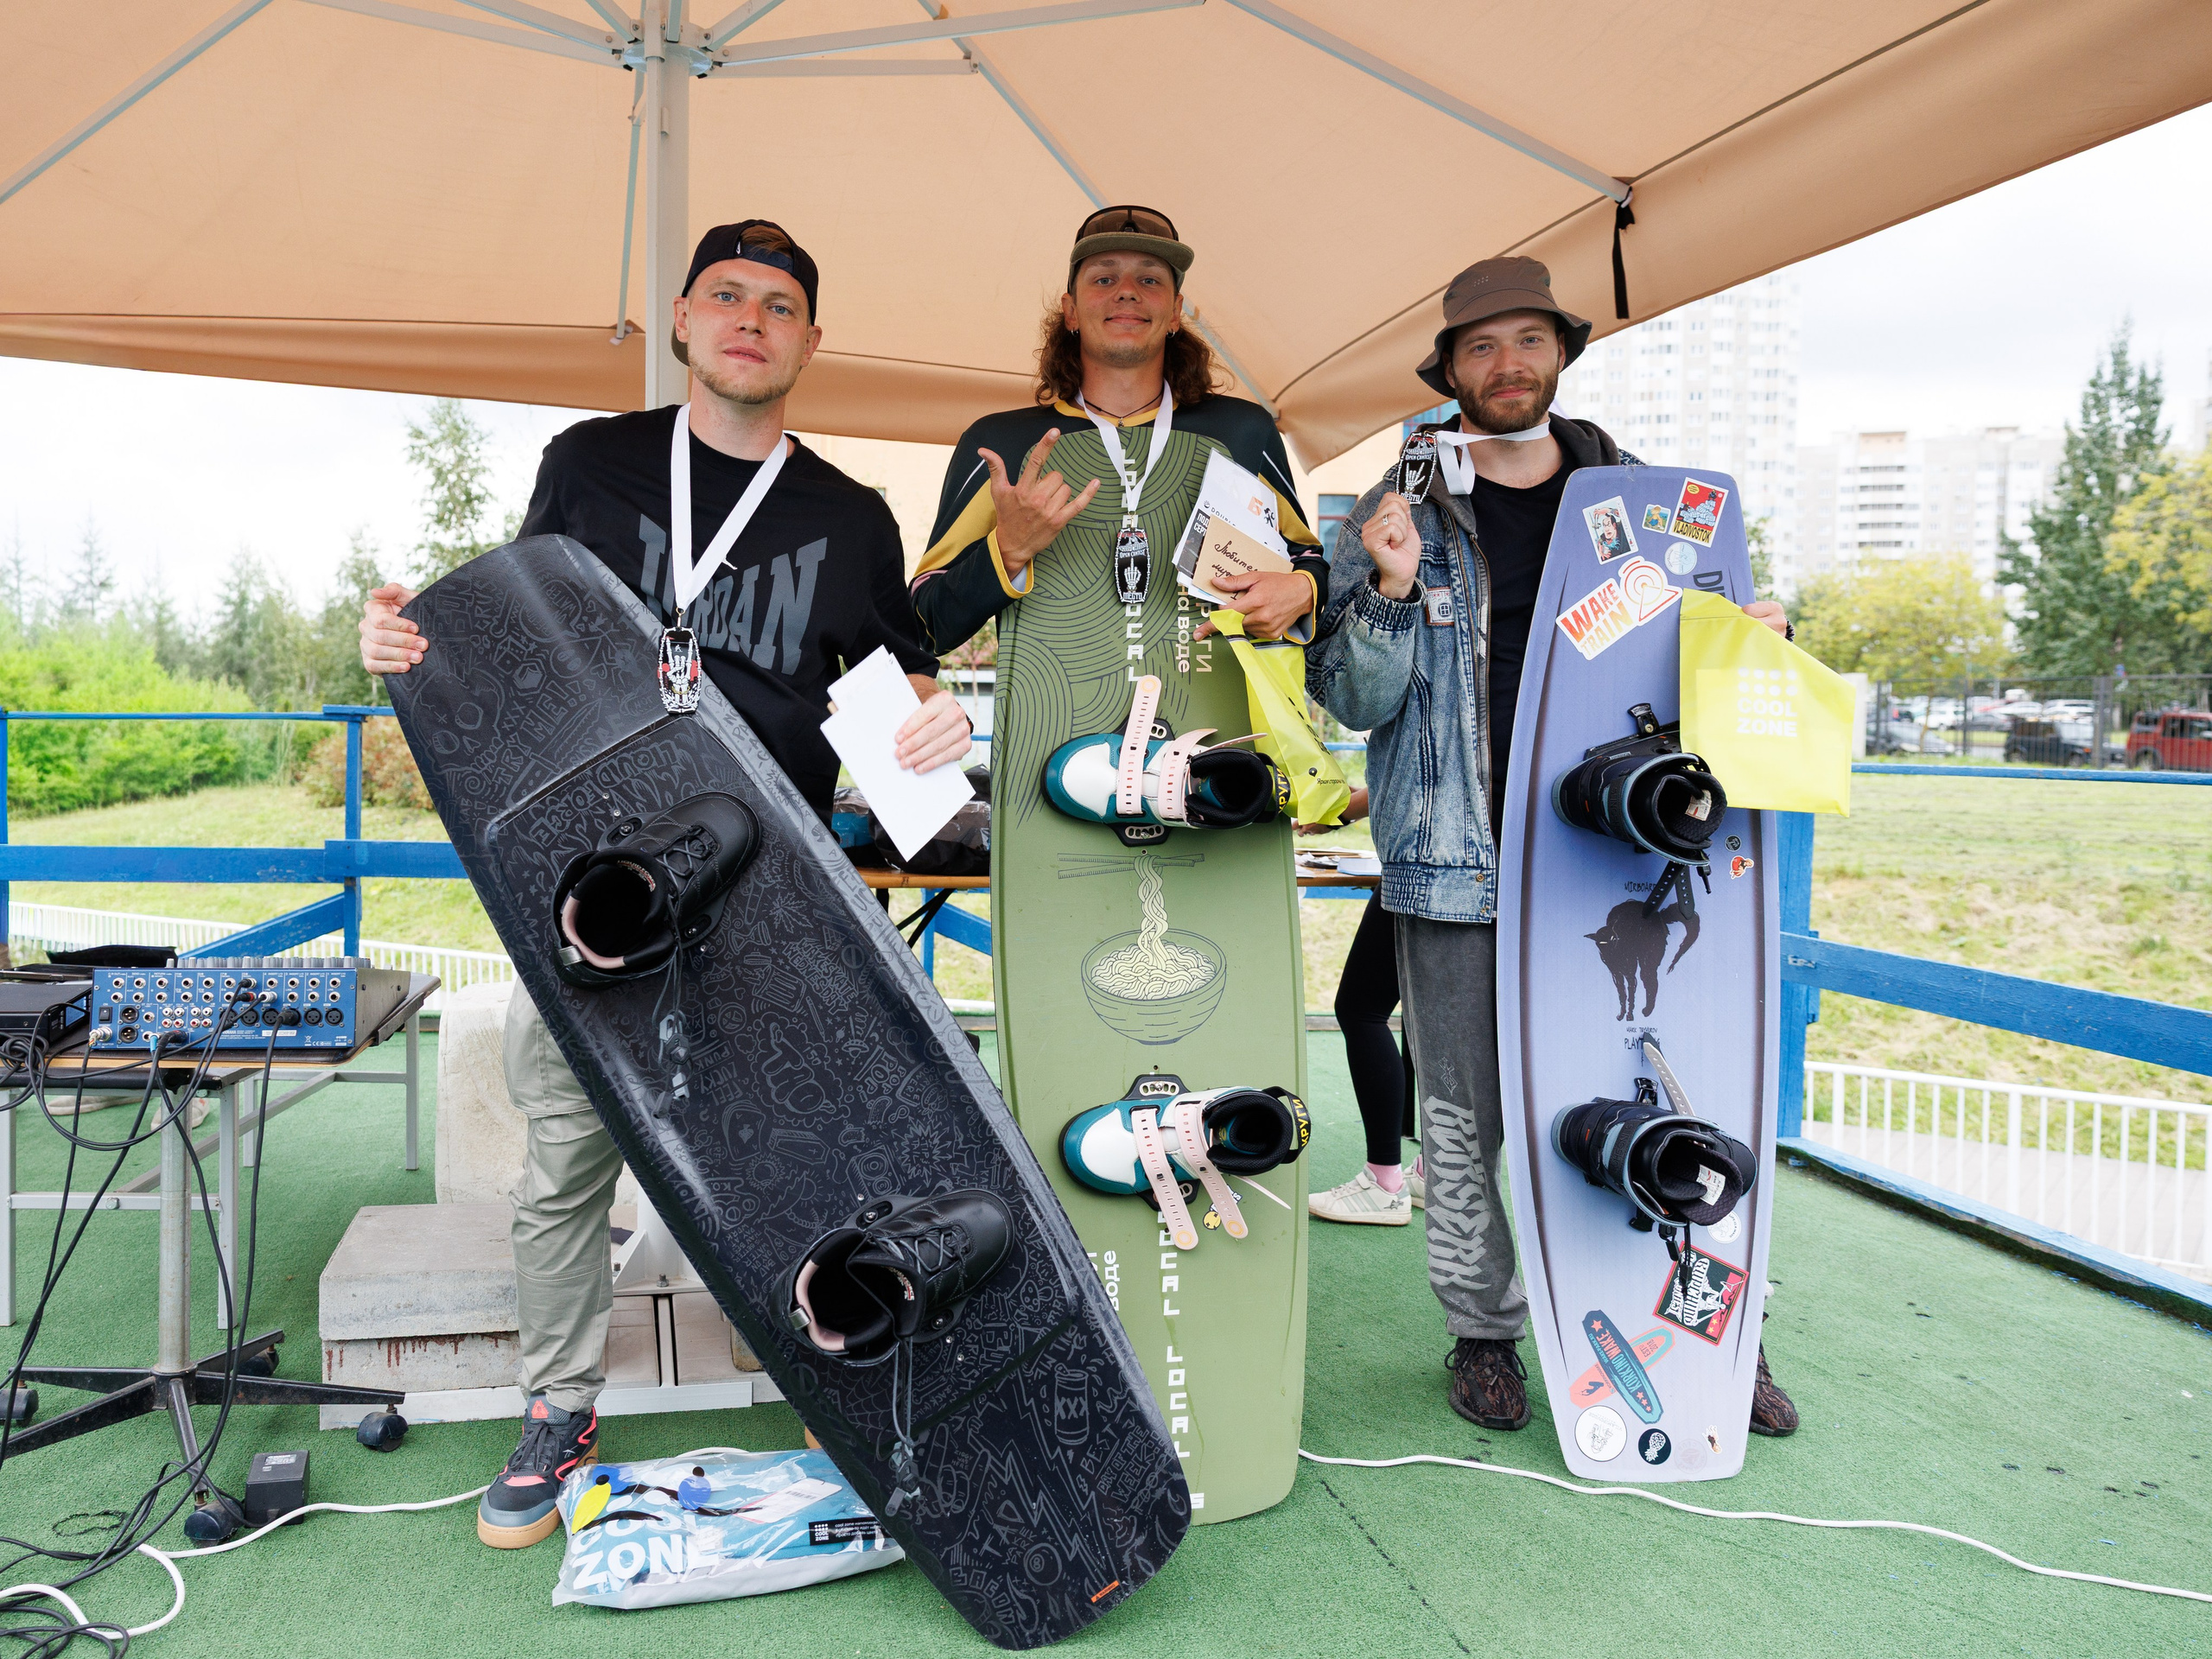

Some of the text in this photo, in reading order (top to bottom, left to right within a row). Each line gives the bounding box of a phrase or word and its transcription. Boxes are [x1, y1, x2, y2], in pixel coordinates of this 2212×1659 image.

[1674, 521, 1712, 543] VLADIVOSTOK
[639, 513, 828, 676] JRDAN
[1560, 583, 1619, 643] WAKE
[1580, 601, 1634, 656] TRAIN
[1737, 717, 1797, 738] ZONE
[1738, 697, 1797, 718] COOL
[596, 741, 680, 790] LIQUID
[783, 941, 852, 1016] WEDNESDAY
[693, 1045, 731, 1071] PUNK
[1293, 1098, 1311, 1147] КРУГИ
[1588, 1333, 1609, 1364] WAKE-PARK.RU
[1647, 1339, 1658, 1353] 2018
[1166, 1345, 1190, 1458] LOCAL
[1080, 1424, 1115, 1476] BEST
